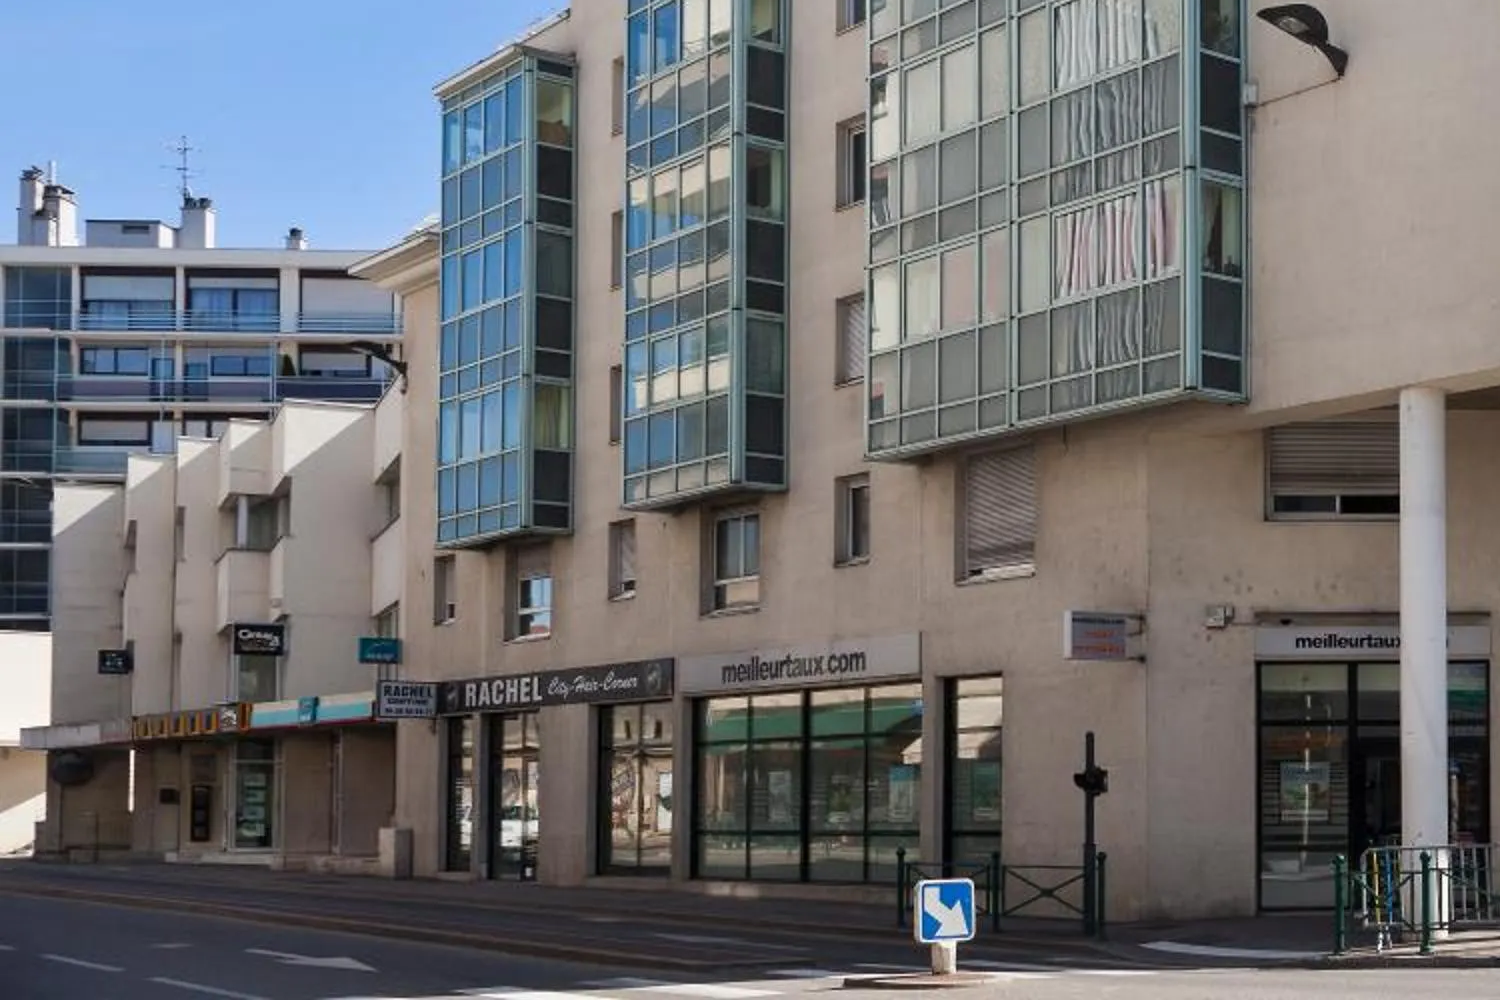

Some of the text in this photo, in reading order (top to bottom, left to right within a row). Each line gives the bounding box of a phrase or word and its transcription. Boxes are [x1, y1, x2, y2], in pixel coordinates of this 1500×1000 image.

[1295, 633, 1448, 649] meilleurtaux
[721, 650, 867, 684] meilleurtaux.com
[383, 685, 433, 697] RACHEL
[465, 675, 543, 707] RACHEL
